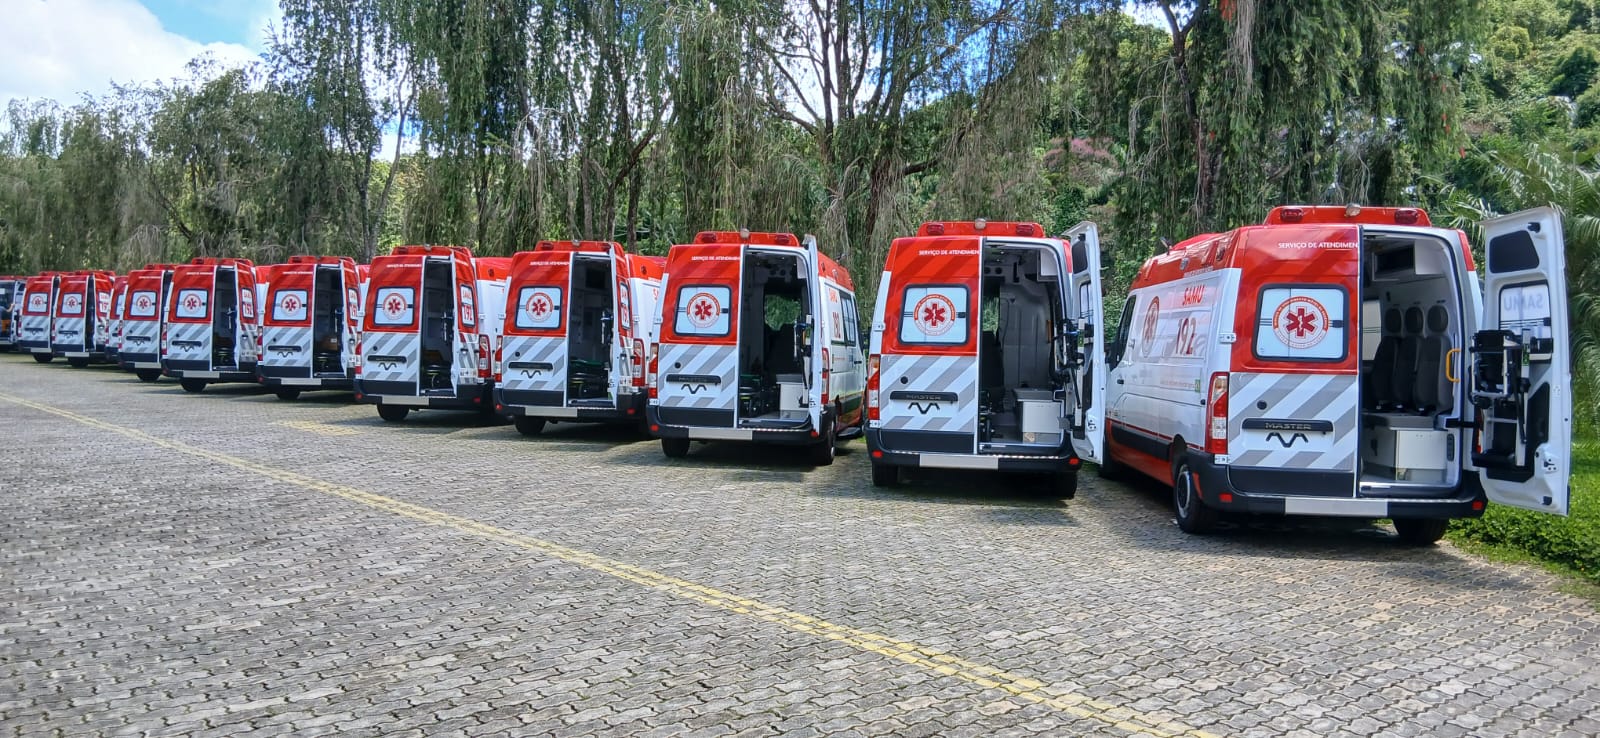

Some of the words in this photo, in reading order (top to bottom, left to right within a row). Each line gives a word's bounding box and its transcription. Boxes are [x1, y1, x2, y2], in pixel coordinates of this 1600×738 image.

[1182, 286, 1205, 306] SAMU
[1175, 317, 1197, 355] 192
[1265, 422, 1312, 430] MASTER
